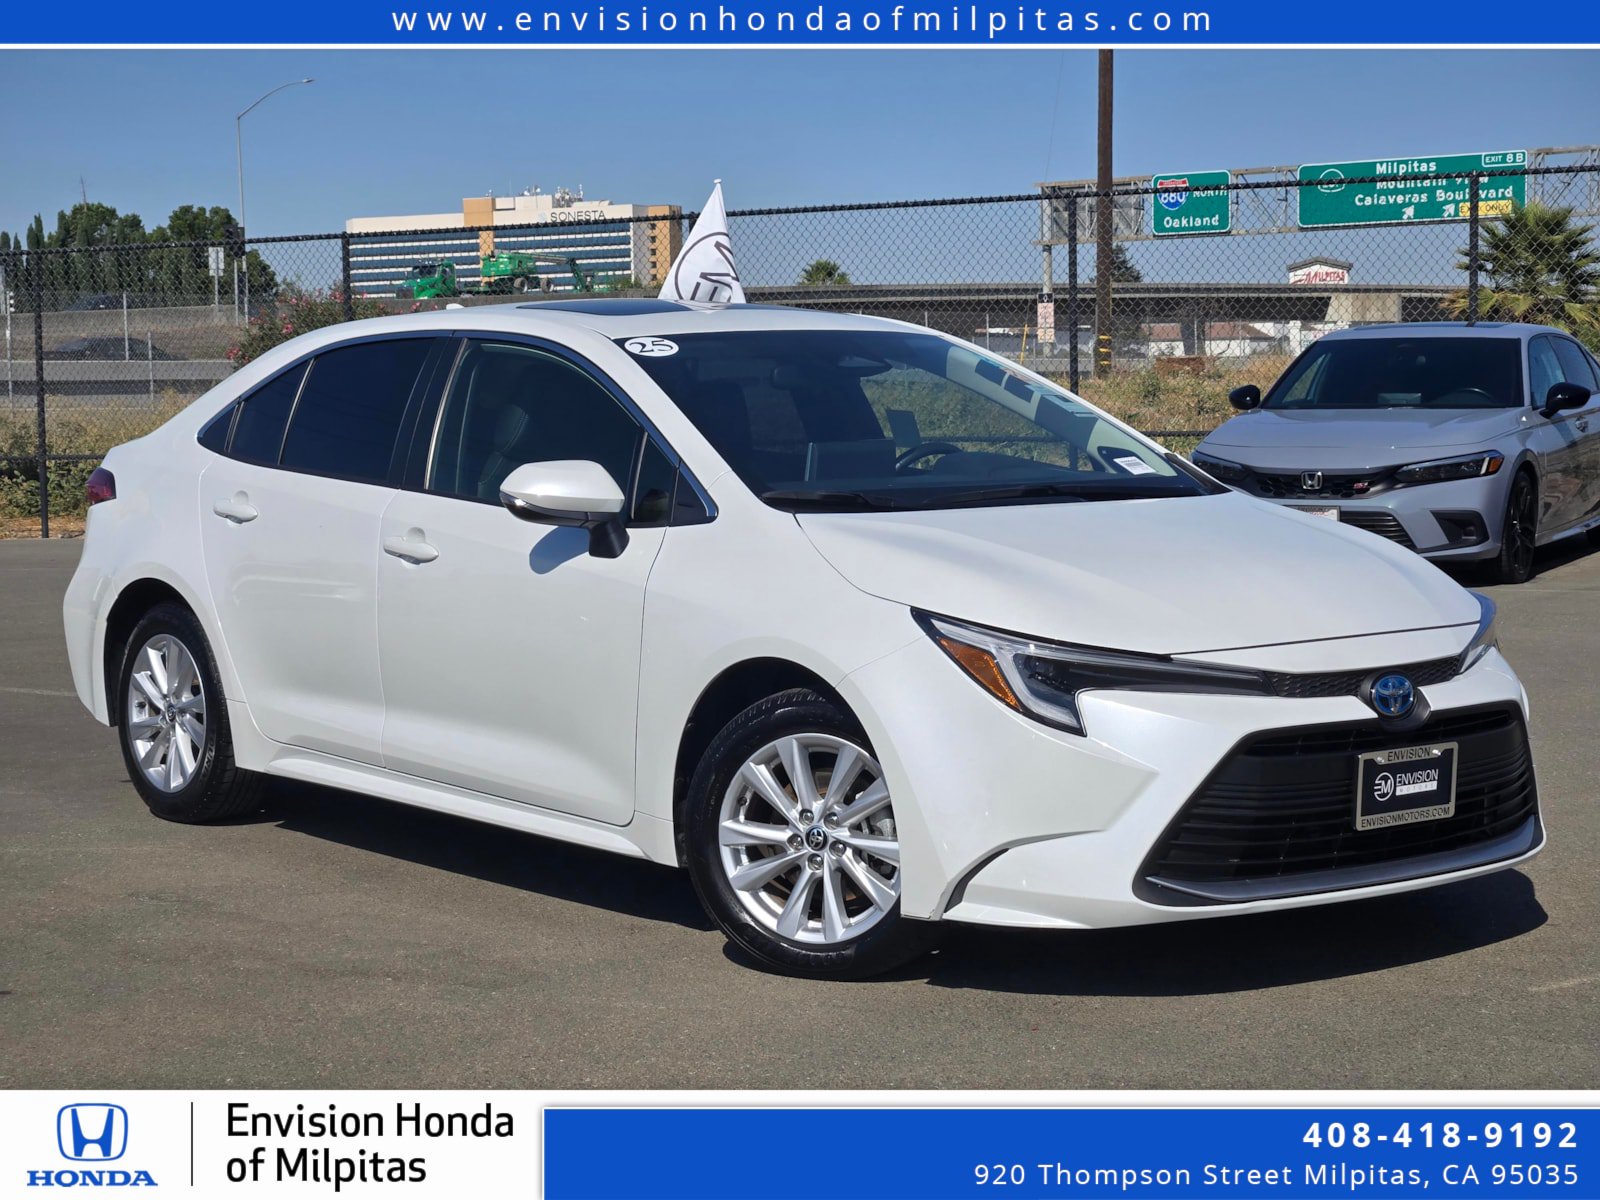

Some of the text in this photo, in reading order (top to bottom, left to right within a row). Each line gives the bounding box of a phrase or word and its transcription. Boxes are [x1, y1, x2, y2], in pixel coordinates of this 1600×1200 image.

[1485, 155, 1502, 163] EXIT
[1376, 160, 1437, 175] Milpitas
[1354, 193, 1428, 206] Calaveras
[1436, 185, 1513, 202] Boulvard
[550, 210, 606, 222] SONESTA
[1163, 214, 1219, 228] Oakland
[629, 340, 674, 353] 25
[1387, 747, 1431, 762] ENVISION
[1396, 769, 1439, 786] ENVISION
[1361, 806, 1450, 828] ENVISIONMOTORS.COM
